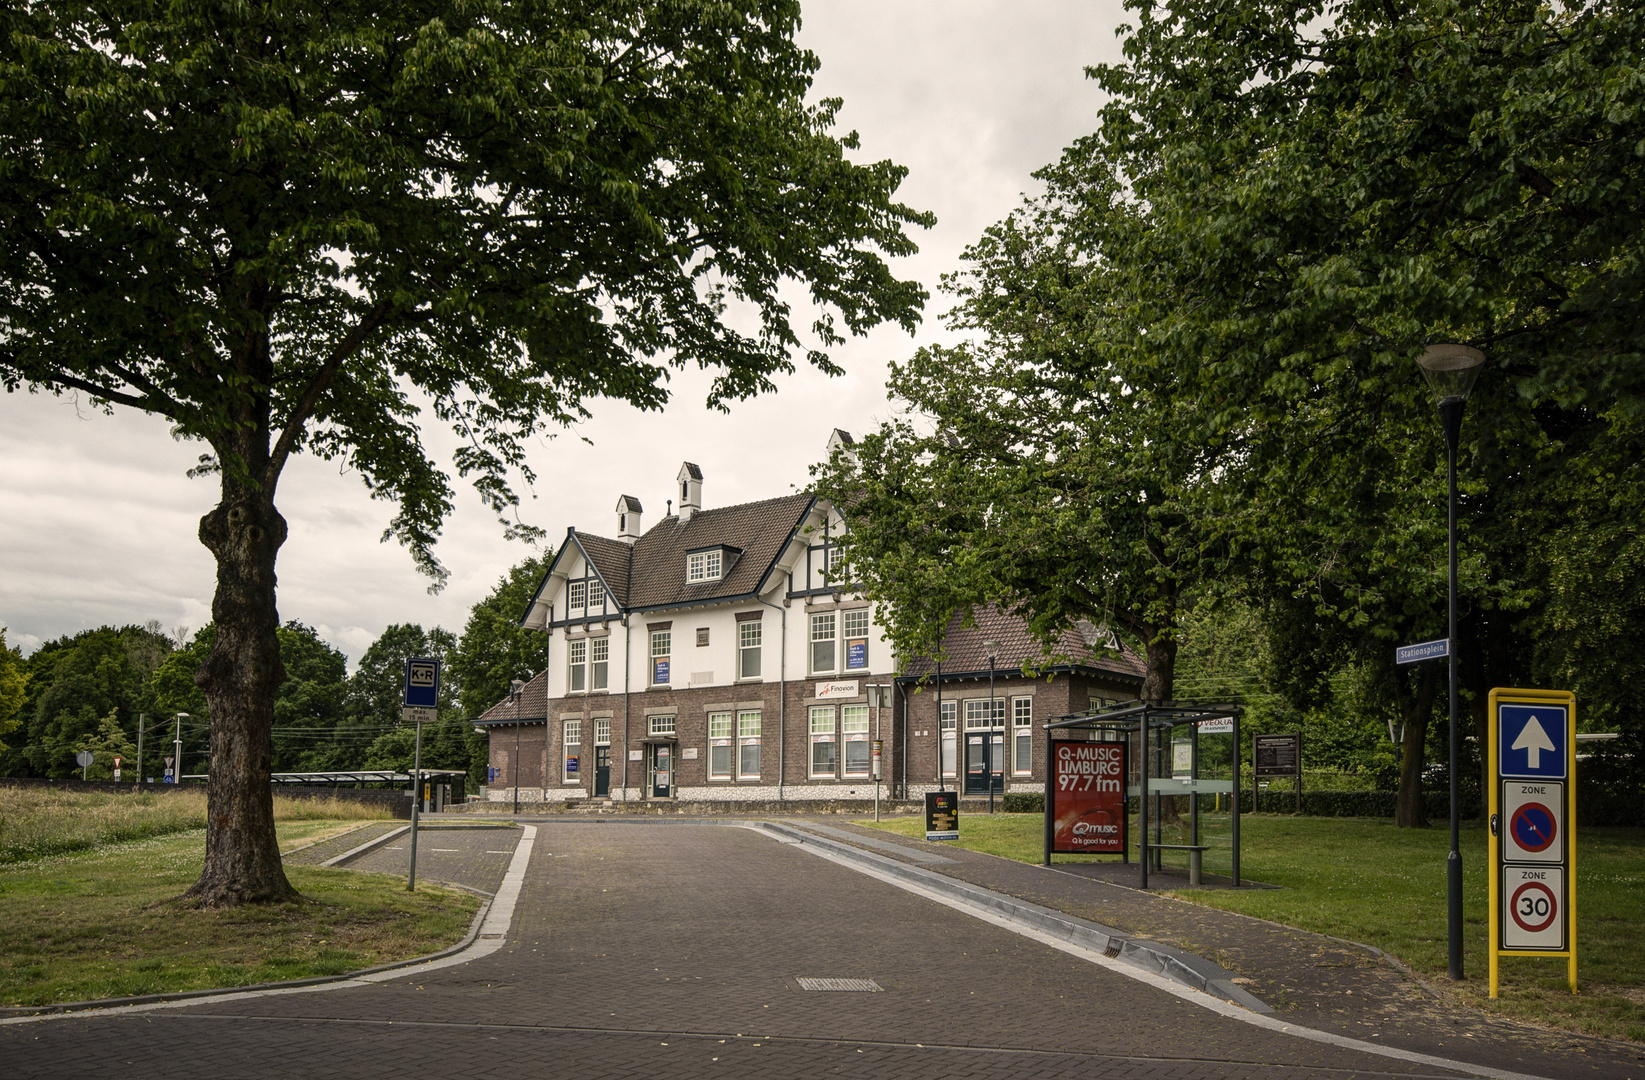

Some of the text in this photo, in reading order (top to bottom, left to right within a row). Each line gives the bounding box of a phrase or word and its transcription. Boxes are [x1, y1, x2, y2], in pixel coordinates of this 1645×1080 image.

[1400, 643, 1444, 659] Stationsplein
[412, 670, 433, 679] K+R
[1058, 746, 1120, 761] Q-MUSIC
[1058, 760, 1120, 775] LIMBURG
[1058, 774, 1120, 792] 97.7 fm
[1521, 786, 1547, 795] ZONE
[1521, 871, 1547, 880] ZONE
[1519, 897, 1549, 917] 30
